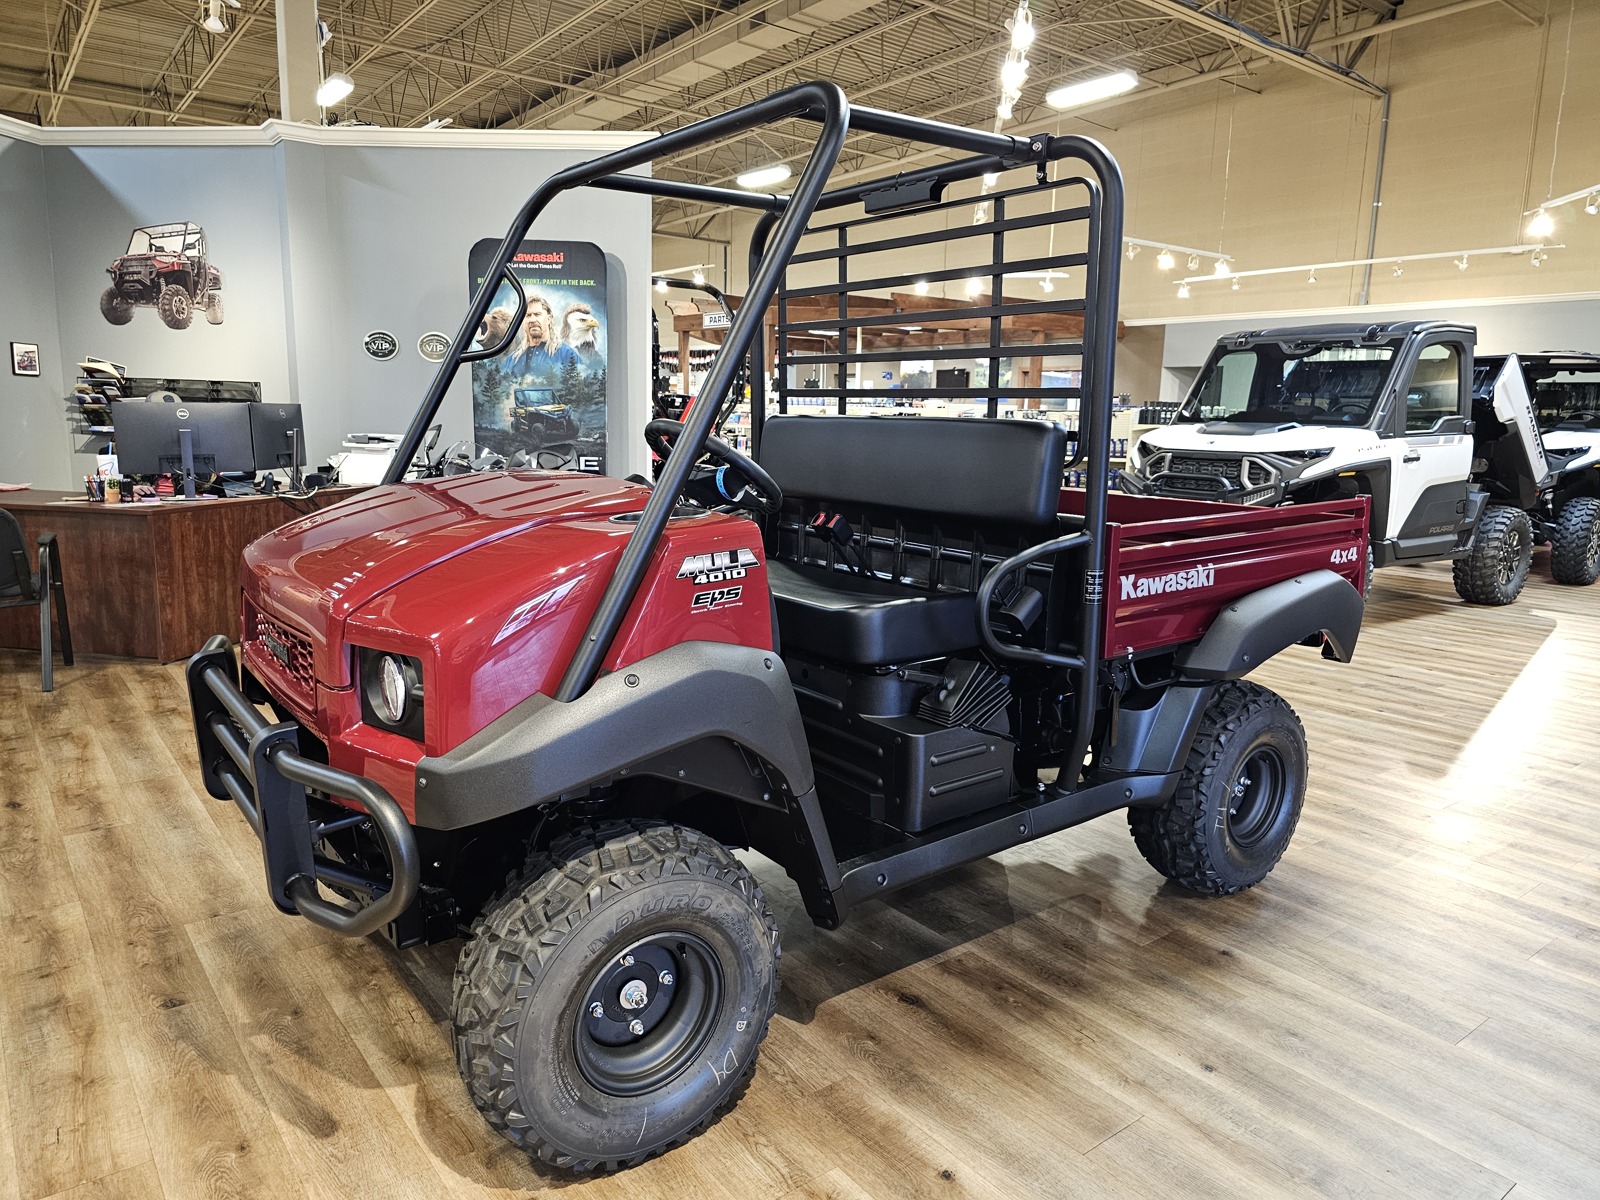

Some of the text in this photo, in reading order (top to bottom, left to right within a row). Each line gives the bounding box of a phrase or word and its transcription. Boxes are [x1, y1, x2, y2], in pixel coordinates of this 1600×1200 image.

[513, 252, 564, 263] awasaki
[709, 315, 730, 324] PARTS
[371, 342, 390, 350] VIP
[425, 344, 444, 352] VIP
[1172, 464, 1238, 478] POLARIS
[1429, 525, 1455, 534] POLARIS
[1330, 547, 1358, 564] 4x4
[676, 548, 760, 579] MULE
[694, 568, 746, 584] 4010
[1120, 563, 1215, 600] Kawasaki
[691, 586, 742, 608] EPS
[614, 894, 713, 933] DURO
